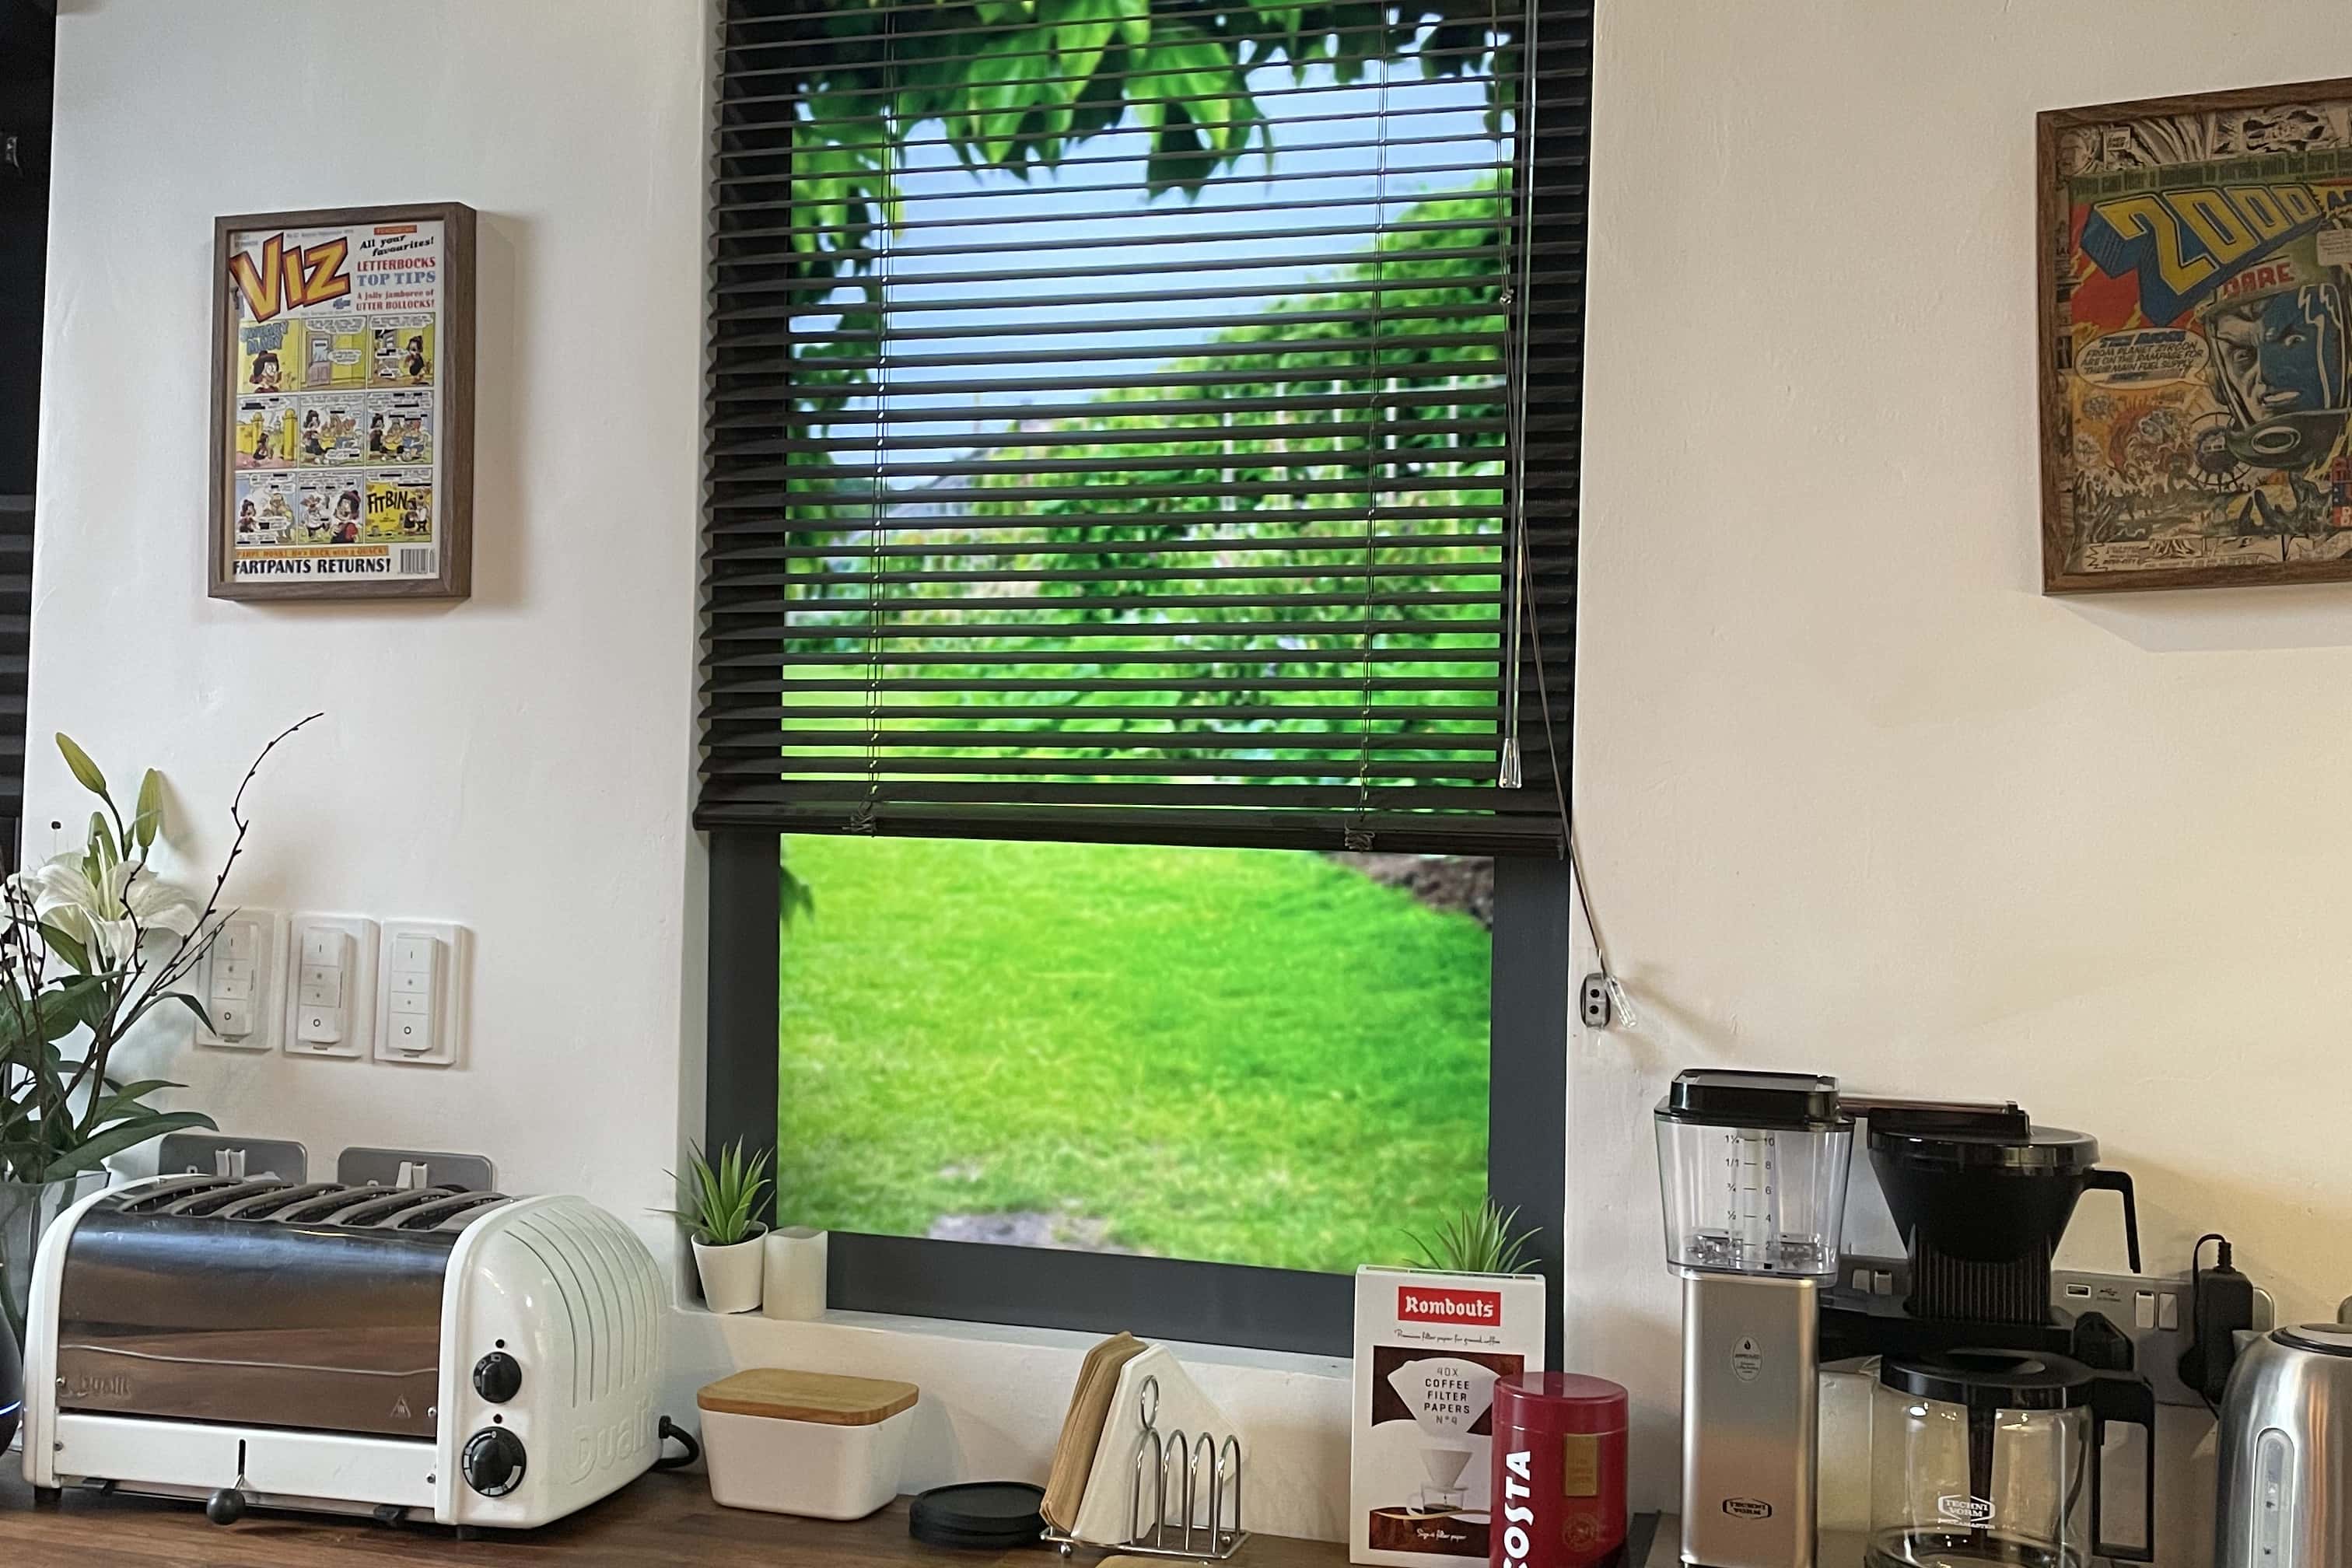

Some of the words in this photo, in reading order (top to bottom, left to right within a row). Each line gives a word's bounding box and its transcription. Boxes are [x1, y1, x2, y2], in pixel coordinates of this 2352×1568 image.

[359, 240, 375, 250] All
[380, 235, 406, 247] your
[2093, 183, 2322, 296] 2000
[372, 236, 434, 256] favourites!
[357, 256, 436, 271] LETTERBOCKS
[356, 273, 390, 286] TOP
[394, 271, 436, 285] TIPS
[2223, 262, 2294, 296] DARE
[356, 302, 383, 310] UTTER
[386, 299, 435, 310] BOLLOCKS!
[2086, 347, 2115, 358] FROM
[2116, 345, 2154, 355] PLANET
[2081, 358, 2100, 367] ARE
[2102, 356, 2116, 365] ON
[2117, 355, 2135, 363] THE
[2184, 349, 2204, 359] FOR
[2112, 362, 2137, 373] MAIN
[2139, 361, 2159, 371] FUEL
[233, 559, 311, 574] FARTPANTS
[317, 558, 391, 573] RETURNS!
[1764, 1137, 1775, 1146] 10
[1726, 1158, 1739, 1167] 1/1
[1766, 1160, 1772, 1170] 8
[1765, 1186, 1772, 1195] 6
[1765, 1213, 1771, 1223] 4
[1405, 1295, 1493, 1318] Rombouts
[1425, 1378, 1469, 1390] COFFEE
[1427, 1390, 1467, 1402] FILTER
[1424, 1402, 1470, 1414] PAPERS
[1503, 1451, 1535, 1568] OSTA
[1945, 1499, 1989, 1511] TECHNI
[1948, 1507, 1983, 1517] VORM
